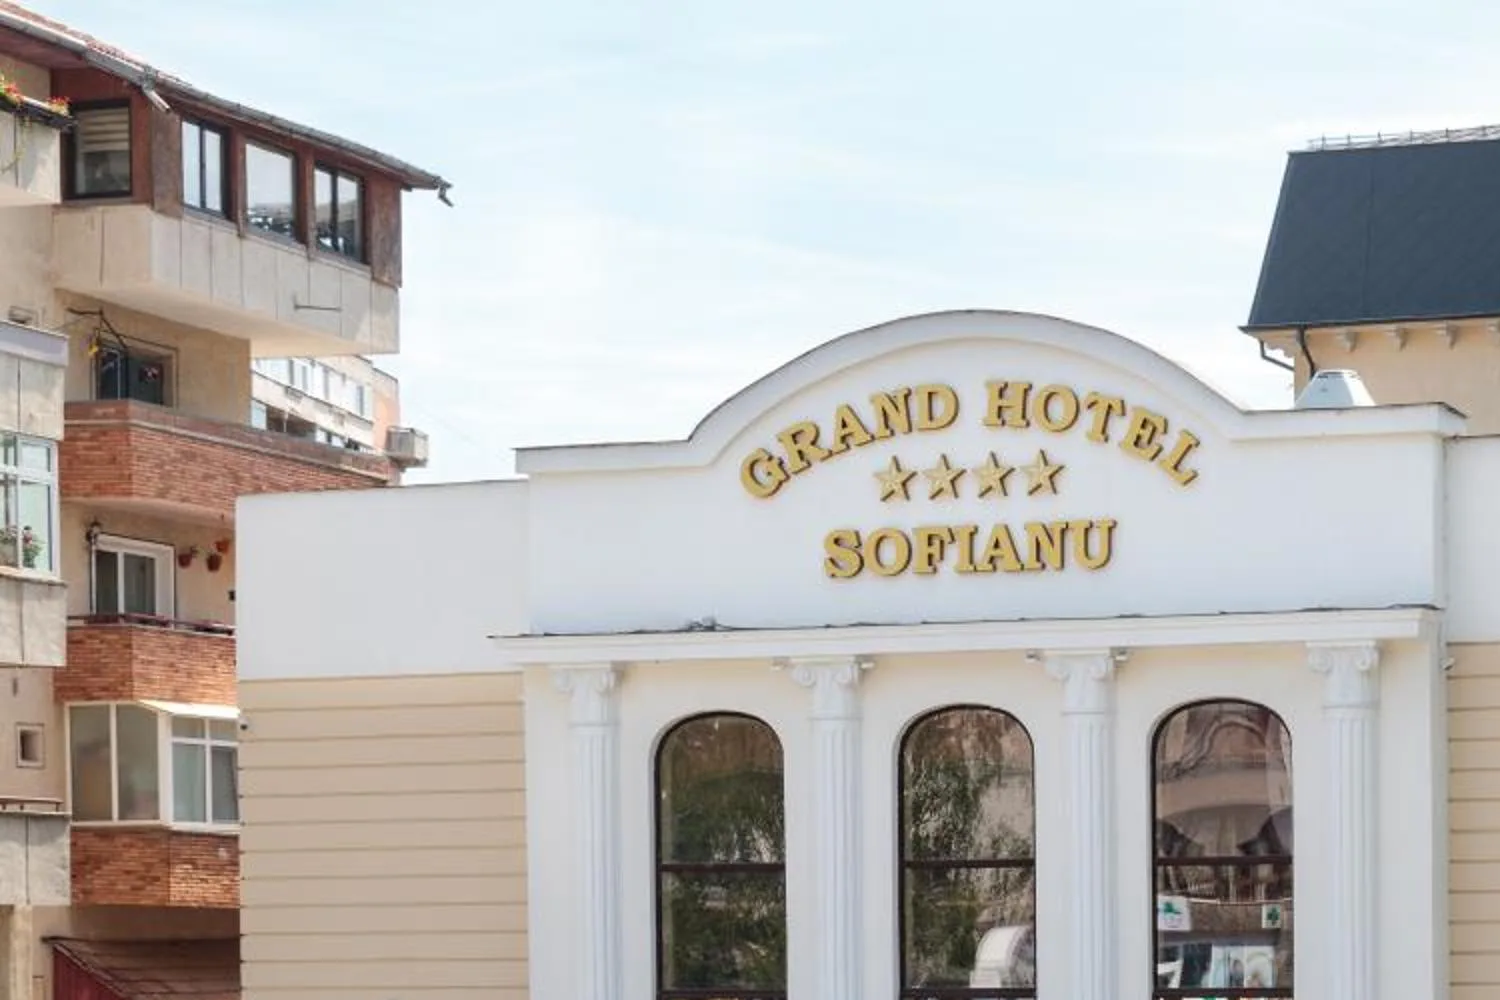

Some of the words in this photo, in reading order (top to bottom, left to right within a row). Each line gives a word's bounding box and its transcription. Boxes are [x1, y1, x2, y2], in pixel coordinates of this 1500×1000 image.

[740, 382, 960, 499] GRAND
[982, 380, 1201, 488] HOTEL
[823, 517, 1117, 579] SOFIANU
